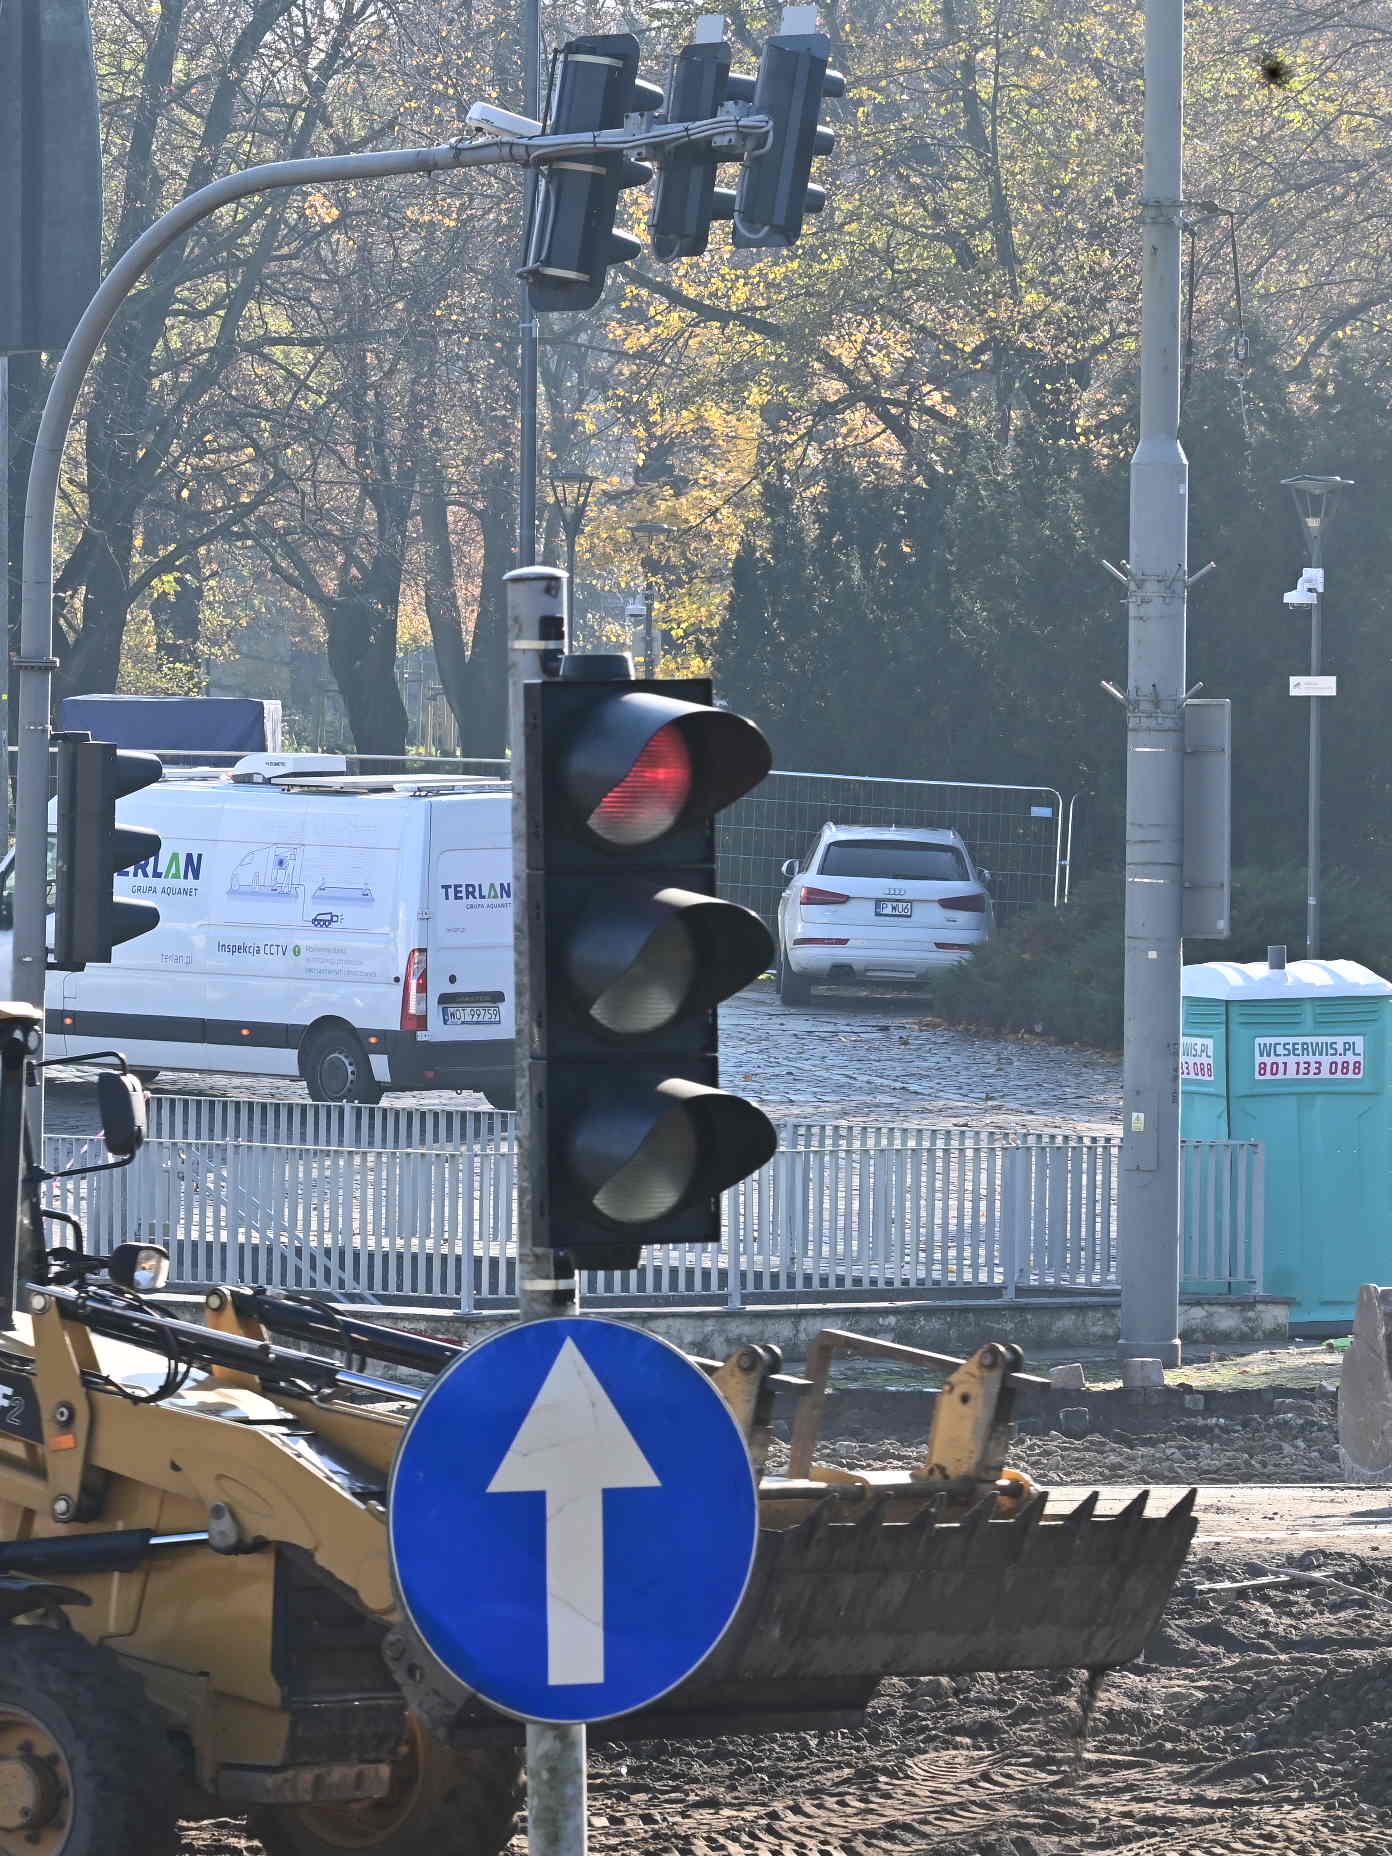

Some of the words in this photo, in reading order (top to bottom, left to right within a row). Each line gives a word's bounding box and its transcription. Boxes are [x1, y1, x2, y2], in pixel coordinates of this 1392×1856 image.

[117, 852, 203, 881] RLAN
[131, 885, 158, 895] GRUPA
[160, 886, 199, 897] AQUANET
[440, 882, 512, 901] TERLAN
[217, 941, 261, 957] Inspekcja
[263, 944, 288, 957] CCTV
[1257, 1041, 1362, 1058] WCSERWIS.PL
[1257, 1061, 1288, 1076] 801
[1295, 1060, 1323, 1076] 133
[1328, 1060, 1362, 1076] 088
